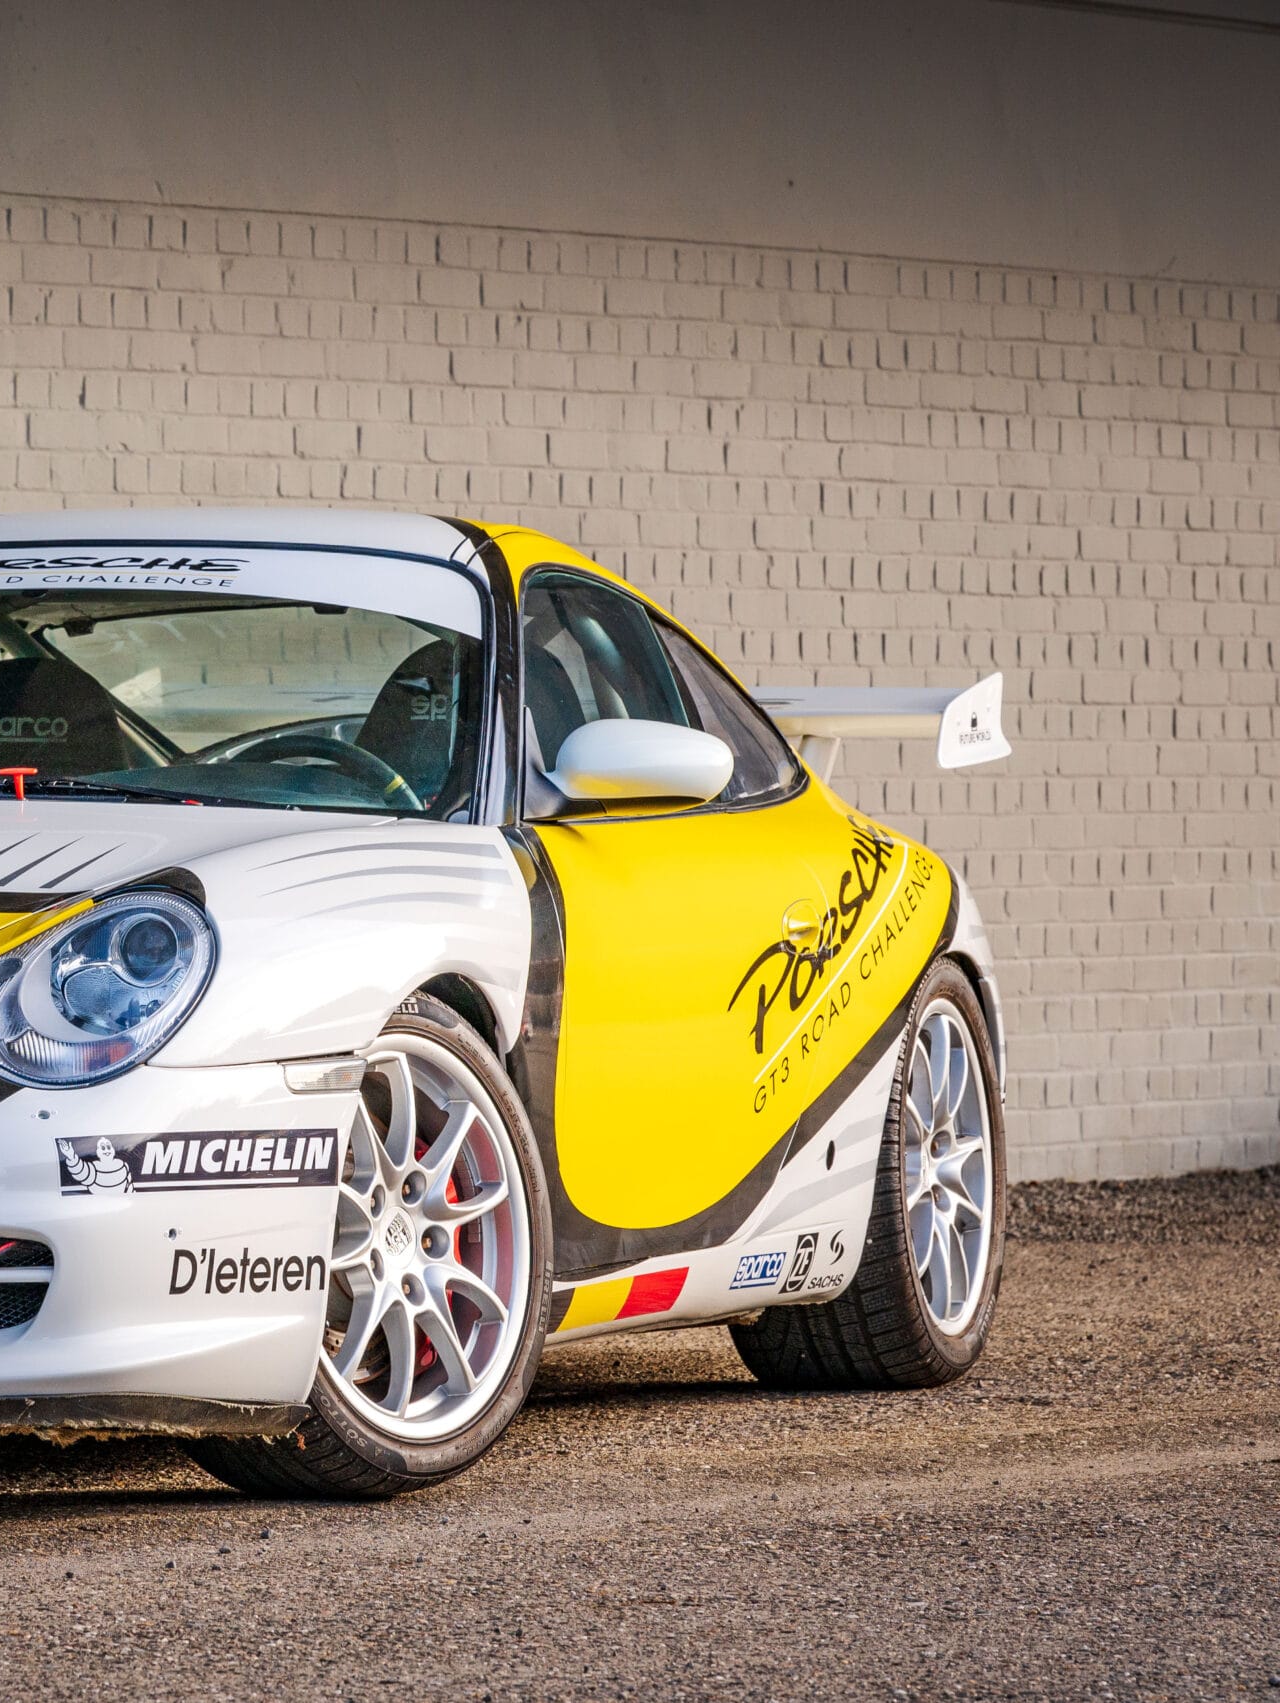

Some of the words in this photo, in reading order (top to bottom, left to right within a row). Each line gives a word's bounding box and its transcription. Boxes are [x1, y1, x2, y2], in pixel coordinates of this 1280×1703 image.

[42, 574, 235, 587] CHALLENGE
[753, 1056, 790, 1114] GT3
[802, 981, 852, 1060] ROAD
[141, 1136, 334, 1175] MICHELIN
[169, 1247, 326, 1295] D'Ieteren
[734, 1252, 785, 1282] sparco
[807, 1273, 845, 1290] SACHS
